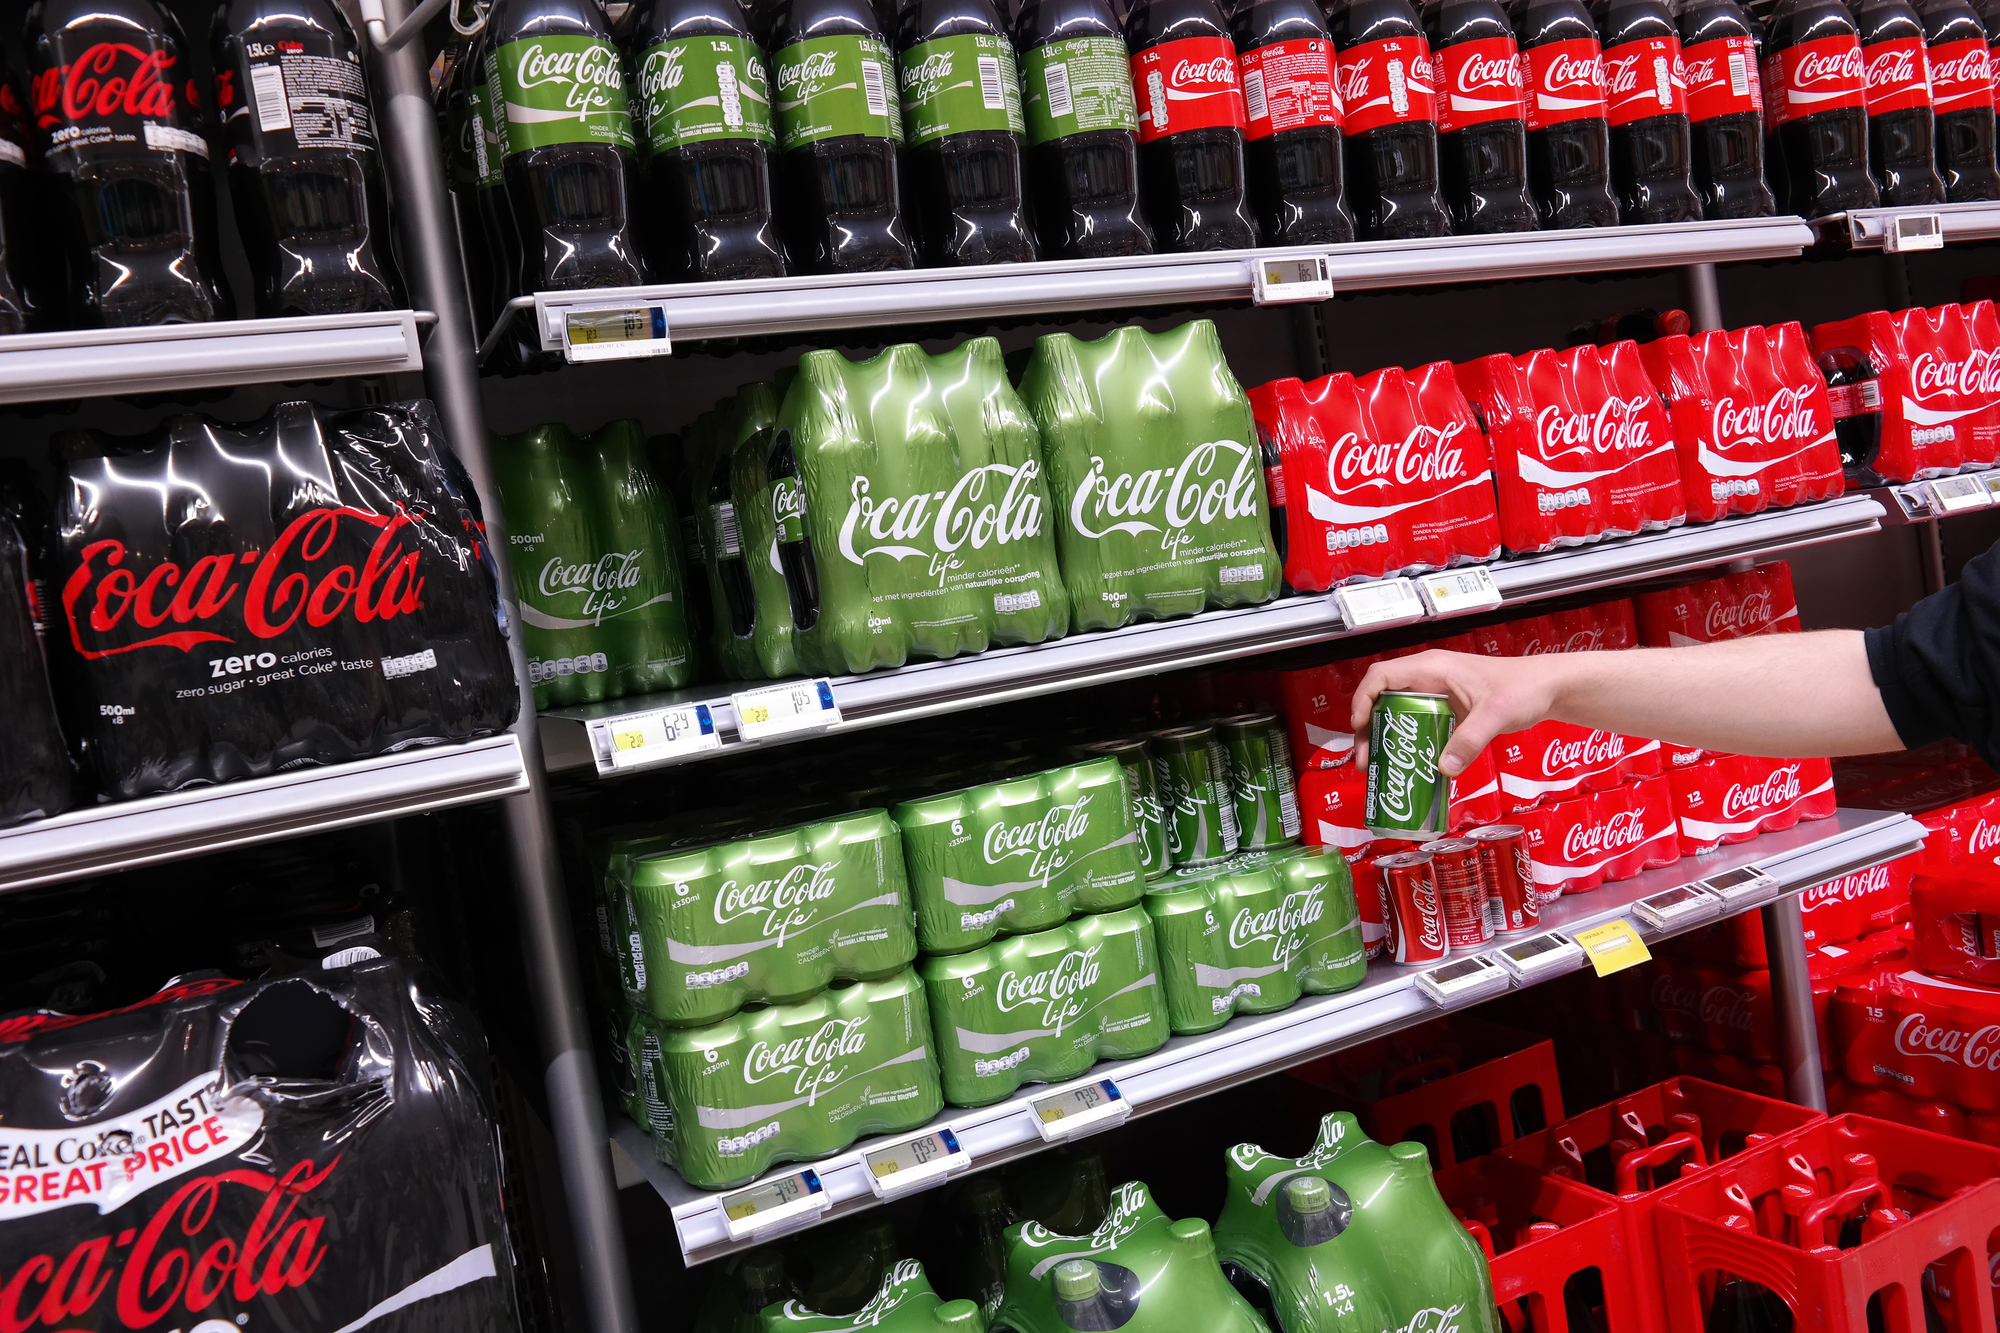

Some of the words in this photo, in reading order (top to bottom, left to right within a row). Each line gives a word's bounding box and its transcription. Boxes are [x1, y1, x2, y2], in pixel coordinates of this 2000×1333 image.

[710, 40, 733, 53] 1.5L
[1142, 52, 1161, 64] 1.5L
[1382, 42, 1402, 52] 1.5L
[1649, 41, 1666, 51] 1.5L
[517, 44, 622, 90] Coca-Cola
[637, 45, 688, 100] -Cola
[778, 51, 838, 92] Coca-Cola
[901, 50, 955, 93] Coca-Cola
[1171, 57, 1235, 87] Coca-Cola
[1794, 46, 1866, 87] Coca-Col
[565, 83, 612, 122] life
[797, 80, 825, 106] life
[917, 80, 943, 106] life
[51, 126, 81, 144] zero
[1537, 395, 1652, 461] Coca-Cola
[1713, 383, 1818, 451] Coca-Cola
[1328, 421, 1466, 495] Coca-Cola
[1070, 439, 1256, 539] Coca-Cola
[510, 533, 545, 545] 500ml
[523, 544, 535, 553] x6
[1161, 528, 1195, 561] life
[1180, 543, 1208, 556] minder
[539, 549, 645, 597] Coca-Cola
[928, 551, 965, 588] life
[1124, 566, 1135, 577] met
[1136, 559, 1182, 576] ingrediënten
[1182, 556, 1194, 565] van
[1195, 550, 1228, 565] natuurlijke
[1229, 545, 1266, 559] oorsprong
[62, 501, 427, 660] Coca-Cola
[893, 592, 908, 602] met
[908, 585, 948, 602] ingrediënten
[949, 583, 964, 592] van
[965, 576, 1002, 592] natuurlijke
[1003, 570, 1041, 587] oorsprong
[947, 570, 976, 584] minder
[582, 593, 628, 627] life
[1102, 591, 1128, 602] 500ml
[1111, 600, 1121, 609] x6
[1674, 603, 1688, 616] 12
[868, 616, 891, 627] 00ml
[1705, 589, 1773, 637] Coca-Cola
[872, 625, 883, 635] x6
[1484, 640, 1499, 653] 12
[209, 649, 276, 679] zero
[280, 645, 333, 665] calories
[175, 685, 205, 699] zero
[207, 676, 246, 697] sugar
[256, 668, 296, 687] great
[340, 655, 375, 672] taste
[99, 703, 136, 719] 500ml
[1312, 694, 1328, 707] 12
[111, 715, 125, 725] x8
[1377, 706, 1420, 822] Coca-Cola
[1415, 736, 1438, 784] life
[1505, 744, 1521, 758] 12
[1507, 753, 1524, 764] x150ml
[1541, 729, 1625, 776] Coca-Cola
[1174, 773, 1207, 817] life
[1235, 760, 1267, 802] life
[1722, 762, 1802, 819] Coca-Cola
[1324, 790, 1340, 805] 12
[1325, 802, 1343, 812] x150ml
[1687, 790, 1702, 803] 12
[1687, 799, 1704, 809] x150ml
[948, 834, 973, 848] x330ml
[950, 819, 964, 836] 6
[983, 793, 1095, 866] Coca-Cola
[1528, 828, 1542, 842] 12
[1563, 806, 1646, 862] Coca-Cola
[1529, 839, 1545, 849] x150ml
[1028, 849, 1074, 889] life
[1514, 847, 1540, 917] Coca-Cola
[671, 893, 701, 910] x330ml
[674, 880, 690, 897] 6
[714, 860, 842, 925] Coca-Cola
[1057, 883, 1075, 896] MINDER
[762, 907, 818, 949] life
[1204, 909, 1215, 924] 6
[1229, 881, 1329, 949] Coca-Cola
[1412, 877, 1444, 951] Coca-Cola
[796, 945, 820, 959] MINDER
[1272, 932, 1310, 972] life
[962, 976, 975, 989] 6
[996, 942, 1104, 1013] Coca-Cola
[1651, 973, 1759, 1032] Coca-Cola
[1866, 1006, 1884, 1018] 15
[1042, 997, 1089, 1038] life
[743, 1015, 871, 1085] Coca-Cola
[1073, 1032, 1091, 1044] MINDER
[1894, 1013, 2000, 1072] Coca-Co
[702, 1058, 730, 1077] x330ml
[704, 1047, 719, 1063] 6
[794, 1063, 848, 1107] life
[828, 1103, 851, 1118] MINDER
[0, 1144, 48, 1170] EAL
[123, 1116, 229, 1182] PRICE
[0, 1153, 342, 1333] ca-Cola
[1323, 1283, 1355, 1307] 1.5L
[1335, 1299, 1355, 1318] x4
